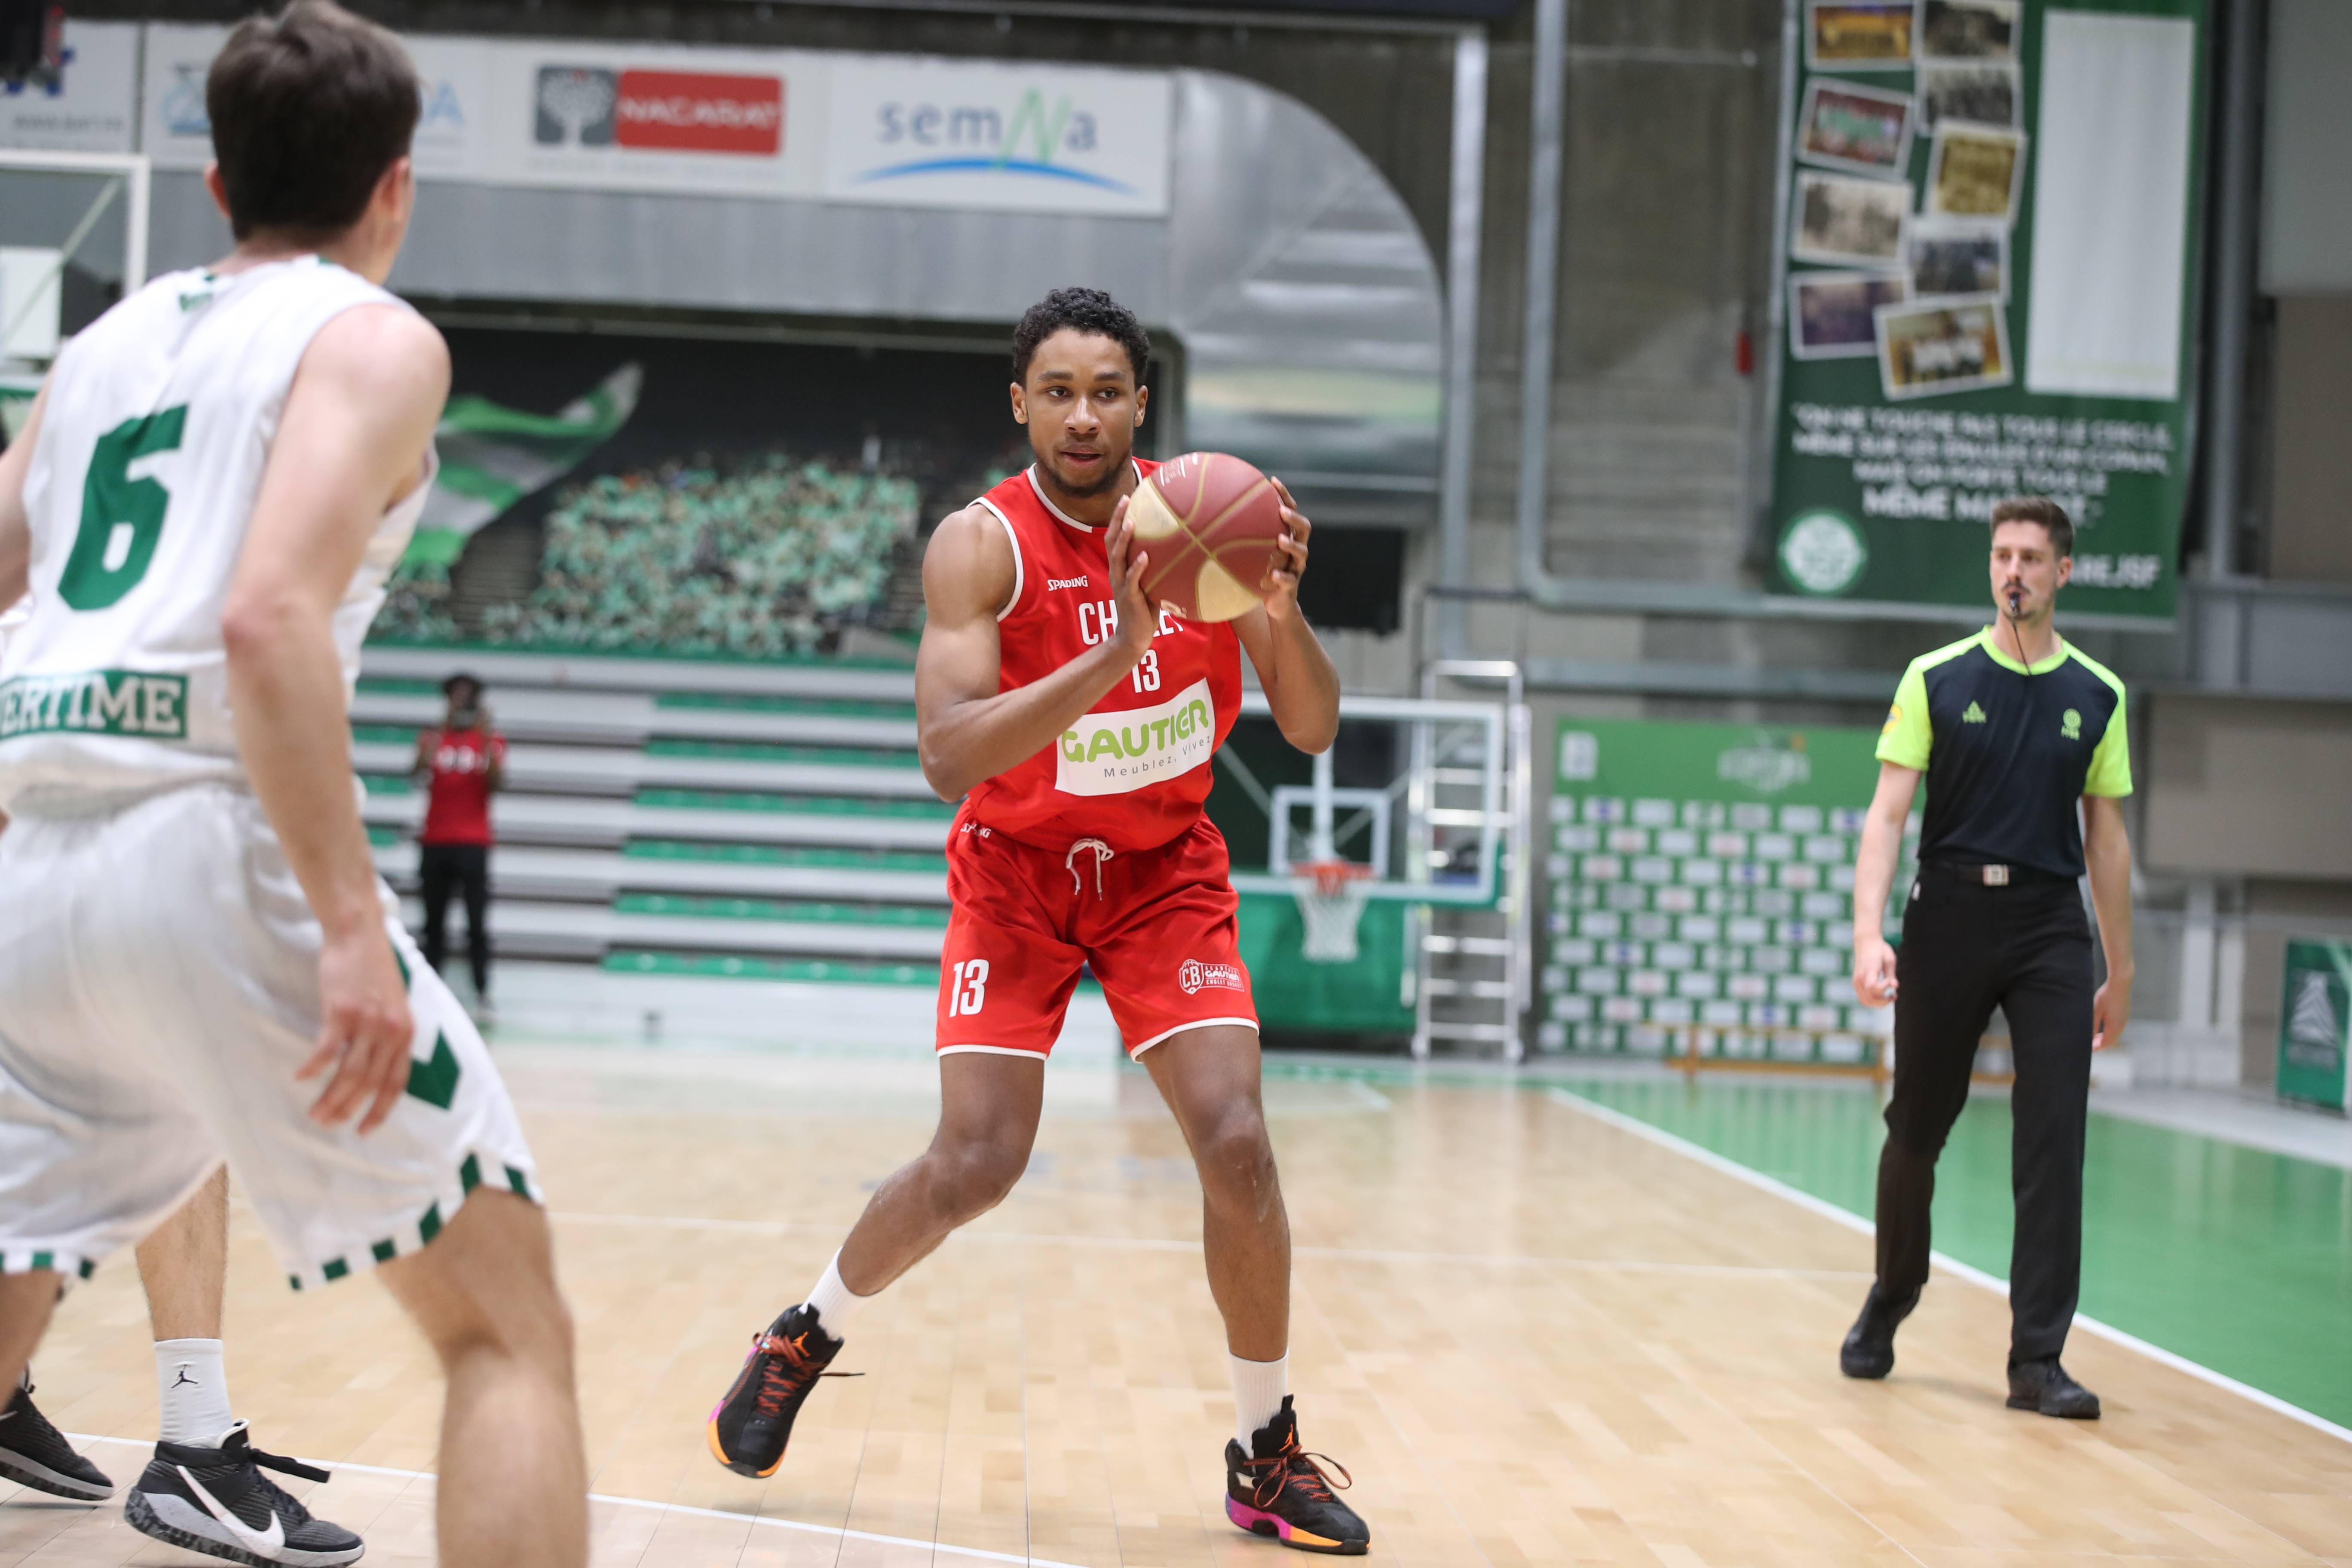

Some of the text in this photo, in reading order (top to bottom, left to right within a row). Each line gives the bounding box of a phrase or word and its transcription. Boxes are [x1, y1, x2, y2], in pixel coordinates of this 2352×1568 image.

[57, 403, 189, 611] 6
[1132, 649, 1161, 693] 13
[1061, 699, 1209, 763] GAUTIER
[1104, 735, 1210, 778] Meublez, Vivez
[949, 959, 989, 1018] 13
[1182, 965, 1201, 988] CB
[1205, 970, 1240, 981] GAUTIER
